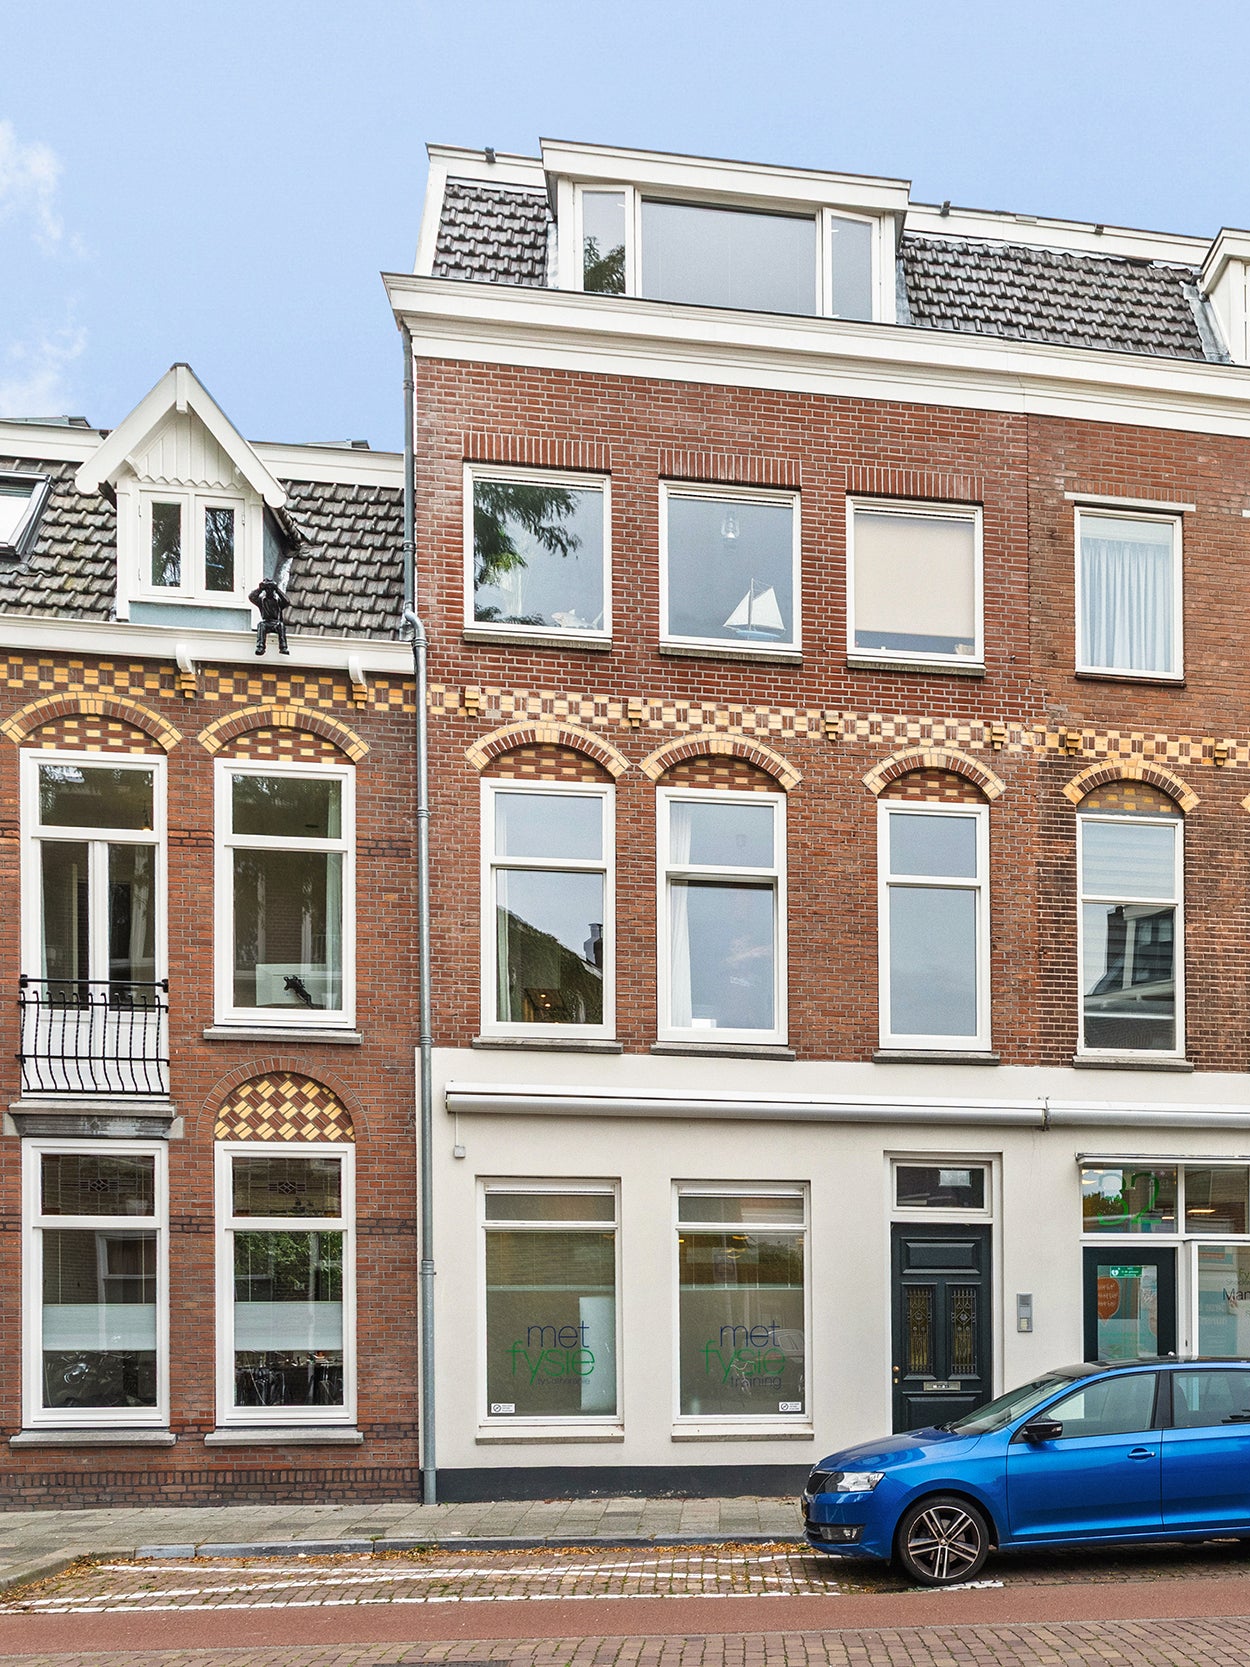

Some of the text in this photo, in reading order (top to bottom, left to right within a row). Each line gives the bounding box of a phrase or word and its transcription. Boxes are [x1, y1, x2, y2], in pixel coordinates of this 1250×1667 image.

[1097, 1172, 1162, 1225] 32
[527, 1320, 590, 1349] met
[720, 1319, 780, 1348] met
[505, 1340, 595, 1386] fysie
[700, 1339, 785, 1385] fysie
